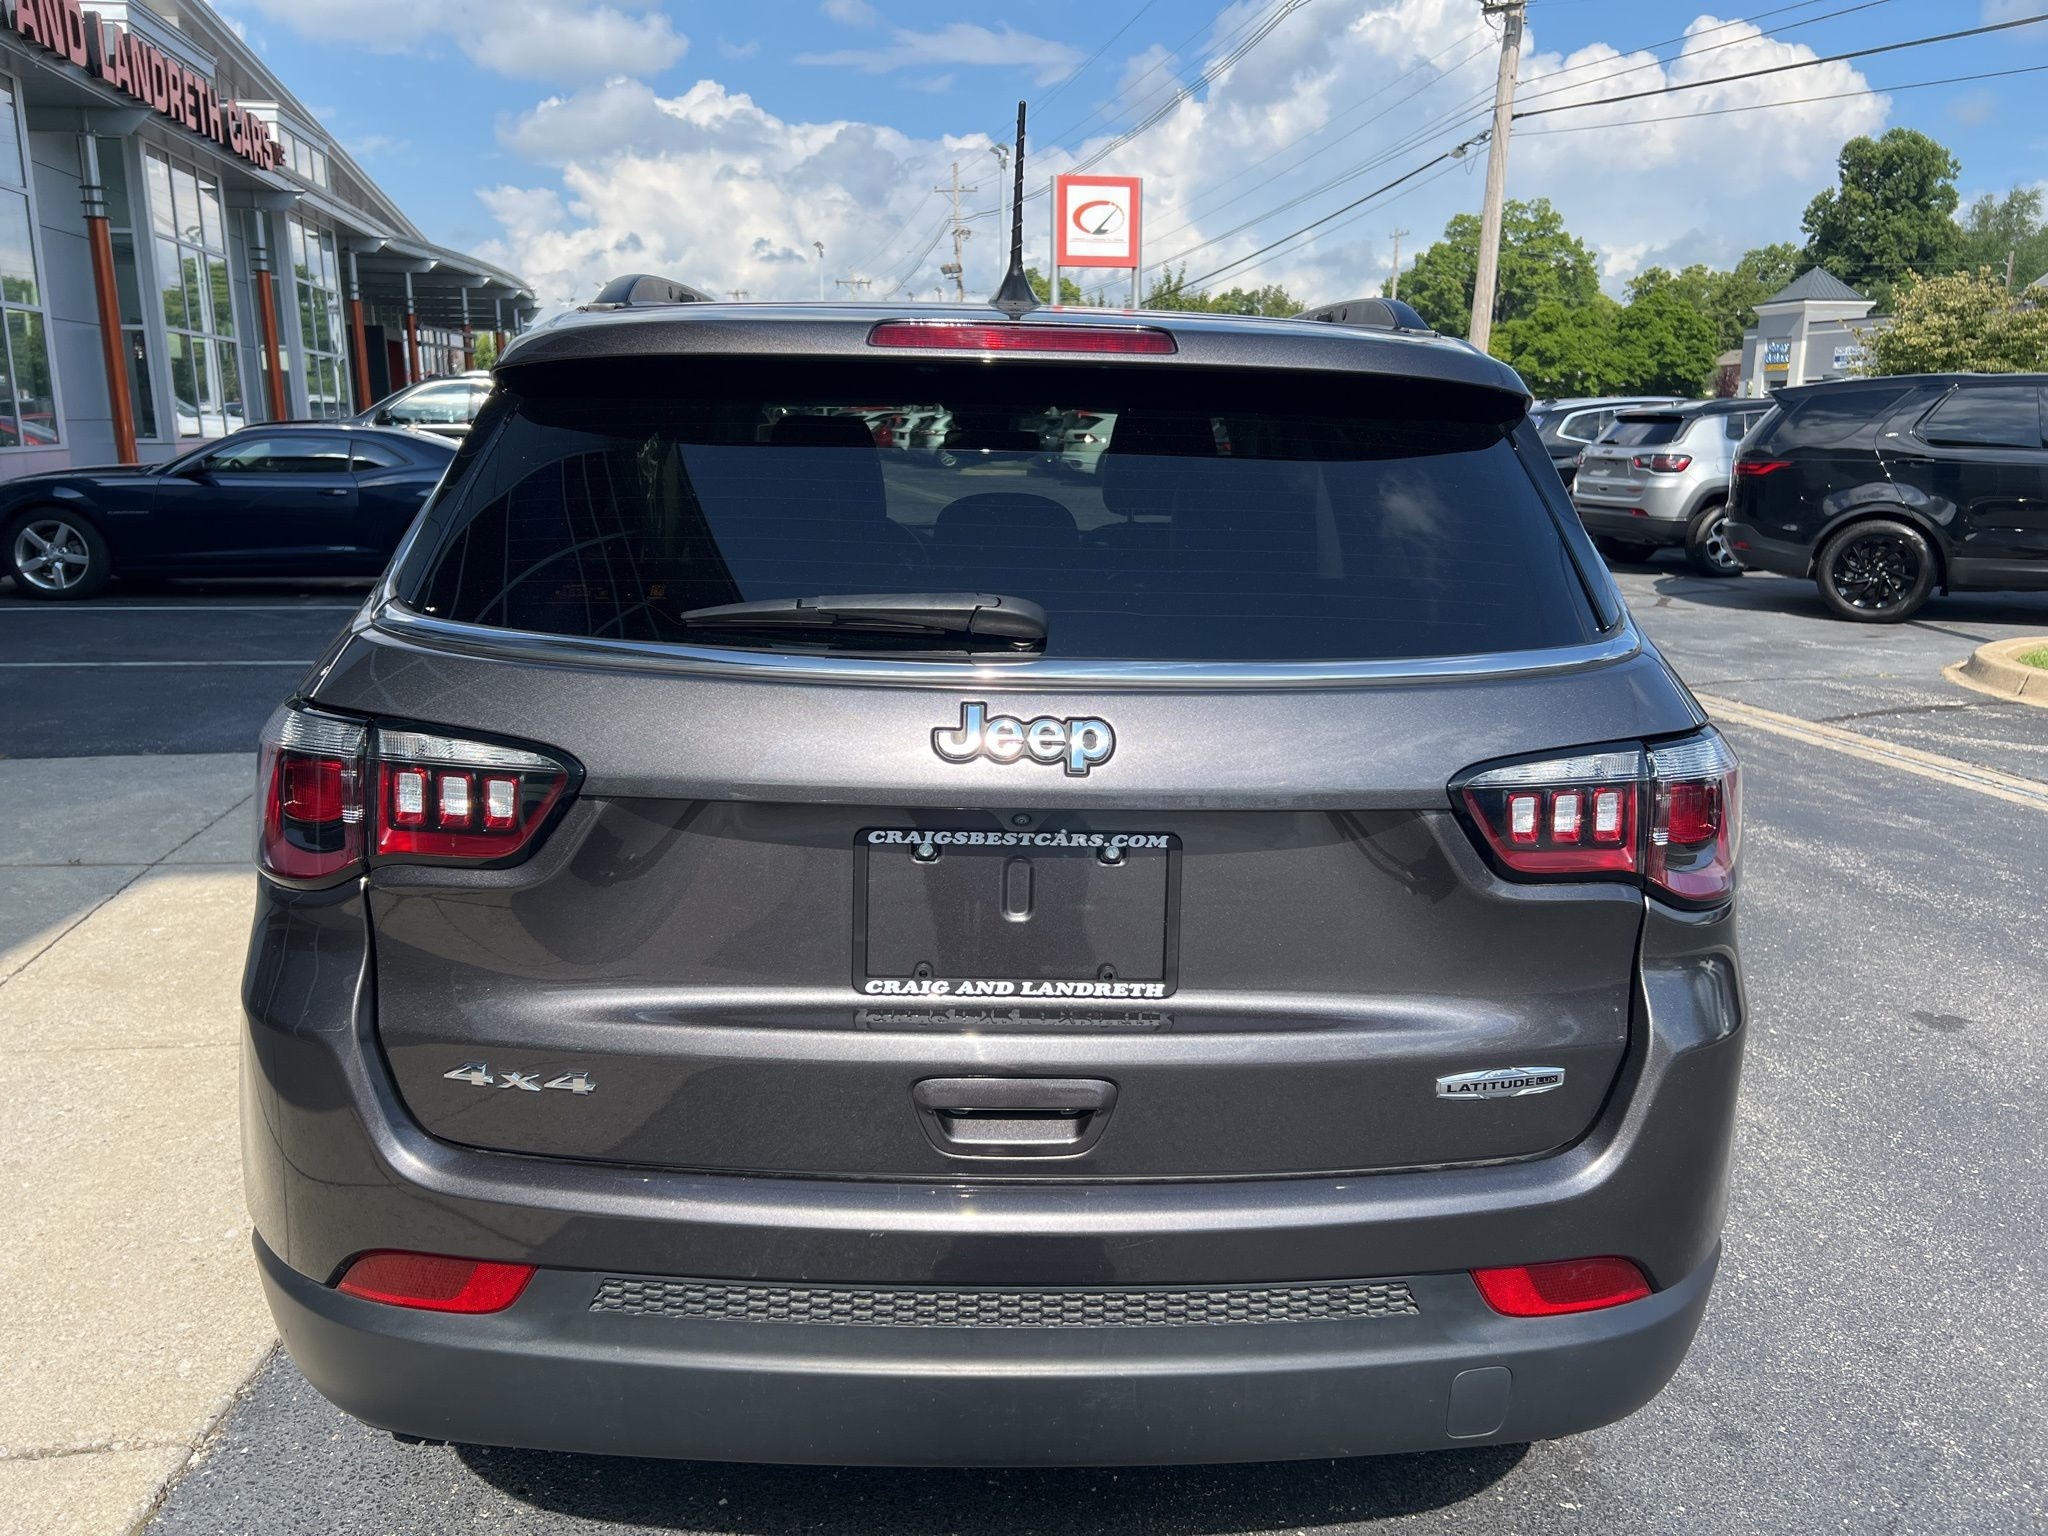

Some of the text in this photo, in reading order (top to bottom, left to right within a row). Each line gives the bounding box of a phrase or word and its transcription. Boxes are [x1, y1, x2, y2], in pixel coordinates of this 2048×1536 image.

[16, 0, 274, 171] AND LANDRETH CARS
[933, 701, 1114, 777] Jeep
[867, 830, 1170, 849] CRAIGSBESTCARS.COM
[864, 979, 1166, 998] CRAIG AND LANDRETH
[1446, 1077, 1535, 1093] LATITUDE
